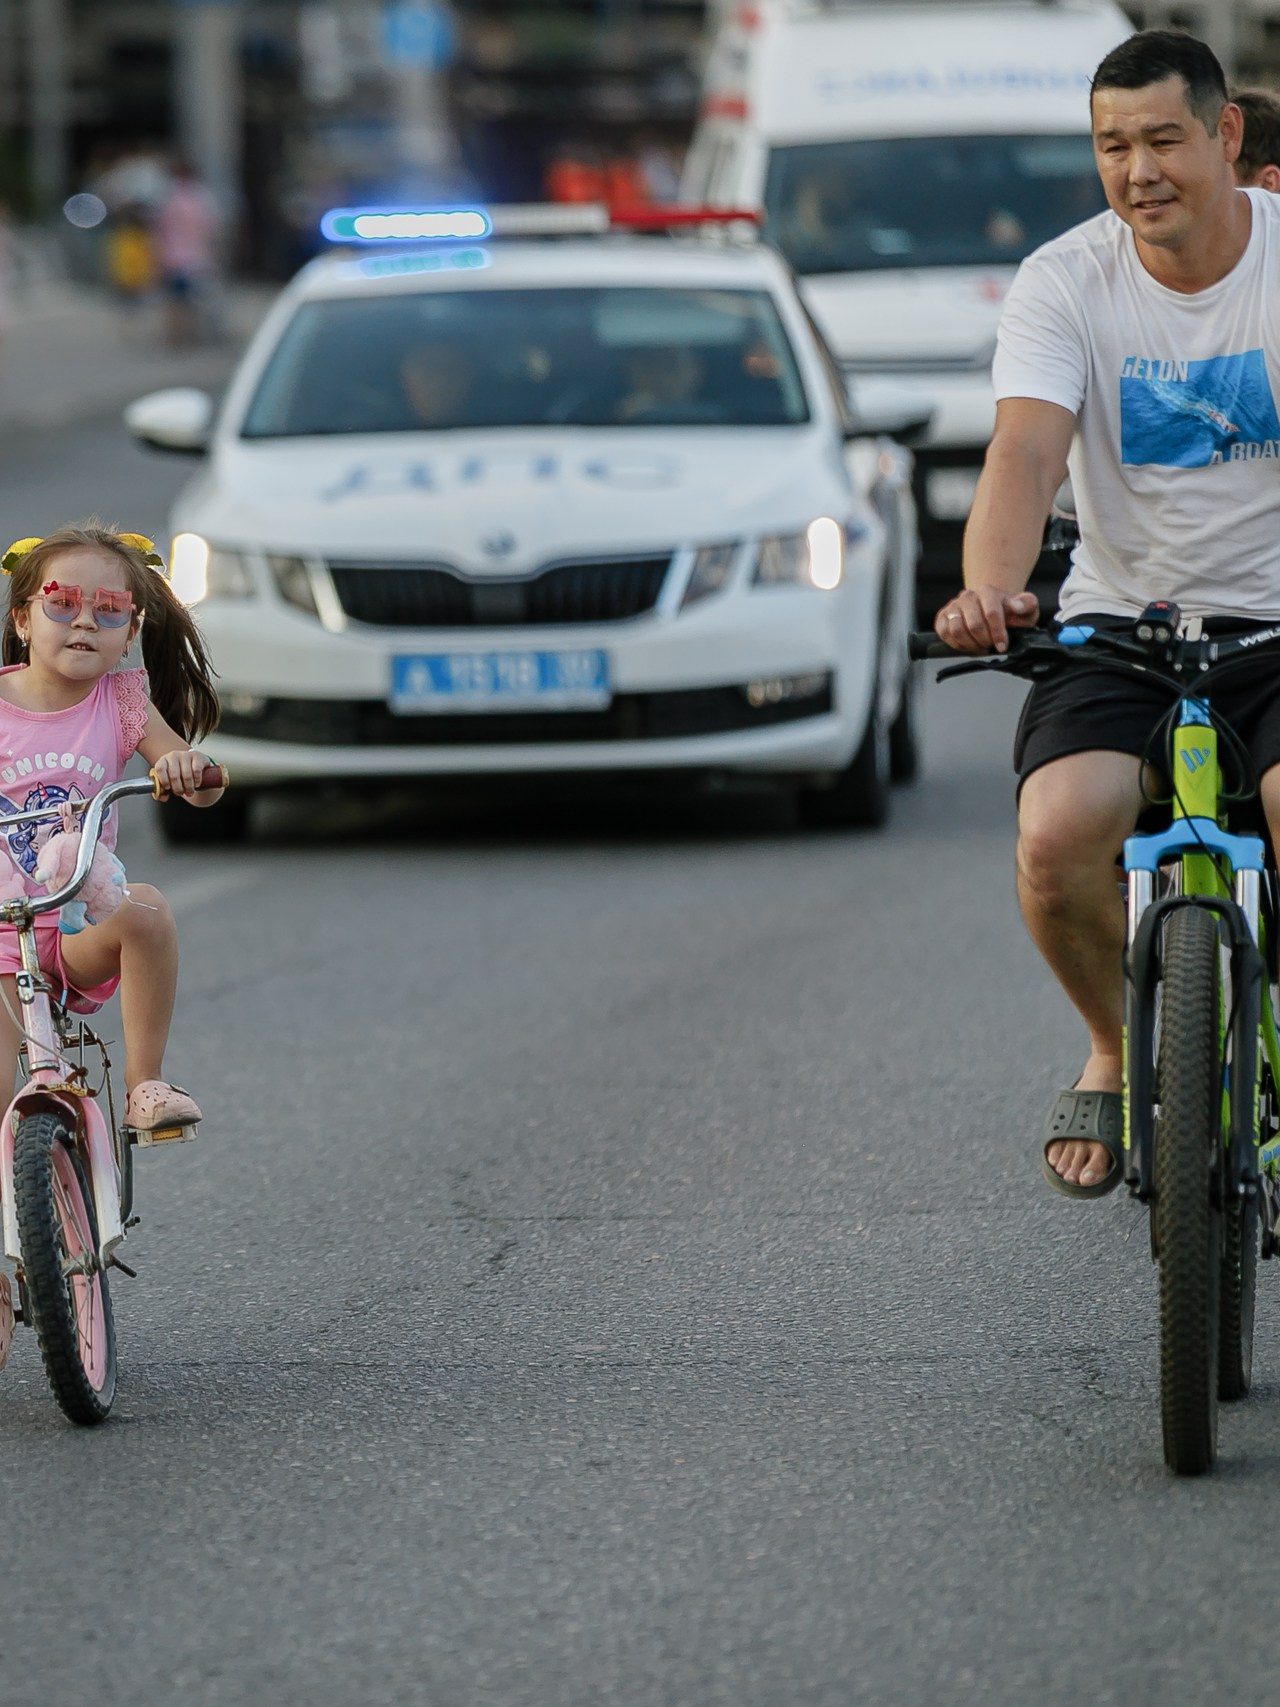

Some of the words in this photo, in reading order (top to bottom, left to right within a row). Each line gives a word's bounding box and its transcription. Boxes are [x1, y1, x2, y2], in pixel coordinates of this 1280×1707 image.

[1121, 355, 1156, 381] GET
[1157, 359, 1188, 383] ON
[1210, 450, 1224, 466] A
[1, 752, 105, 784] UNICORN
